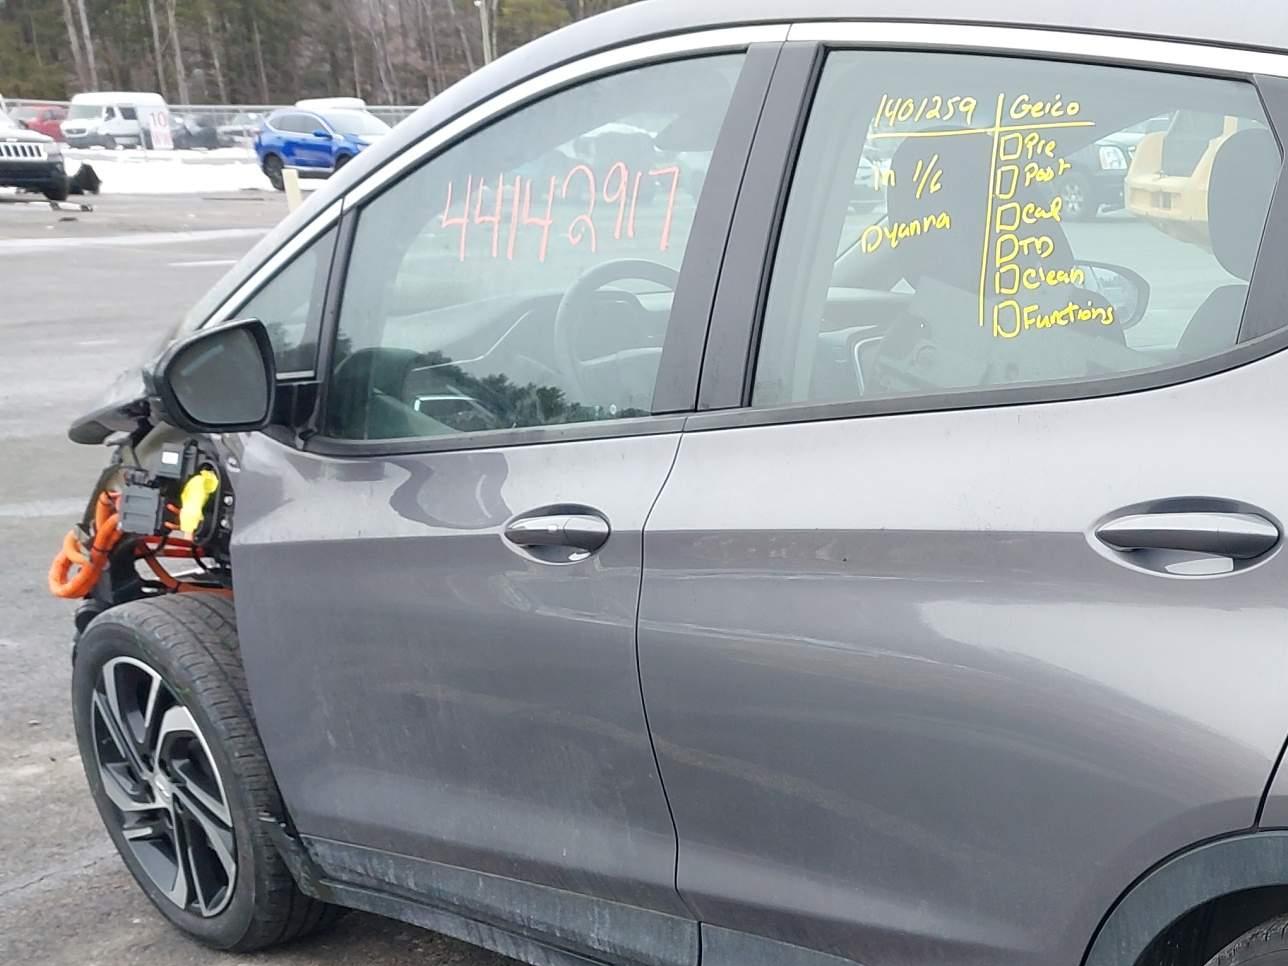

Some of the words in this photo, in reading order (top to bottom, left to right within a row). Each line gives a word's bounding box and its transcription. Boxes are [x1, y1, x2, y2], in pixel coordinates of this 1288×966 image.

[874, 94, 977, 128] 1401259
[1009, 93, 1081, 119] Geico
[1024, 131, 1056, 159] Pre
[912, 153, 943, 199] 1/6
[441, 161, 680, 262] 44142917
[861, 212, 951, 253] Dyanna
[1022, 267, 1085, 289] Clean
[1022, 300, 1114, 329] Functions
